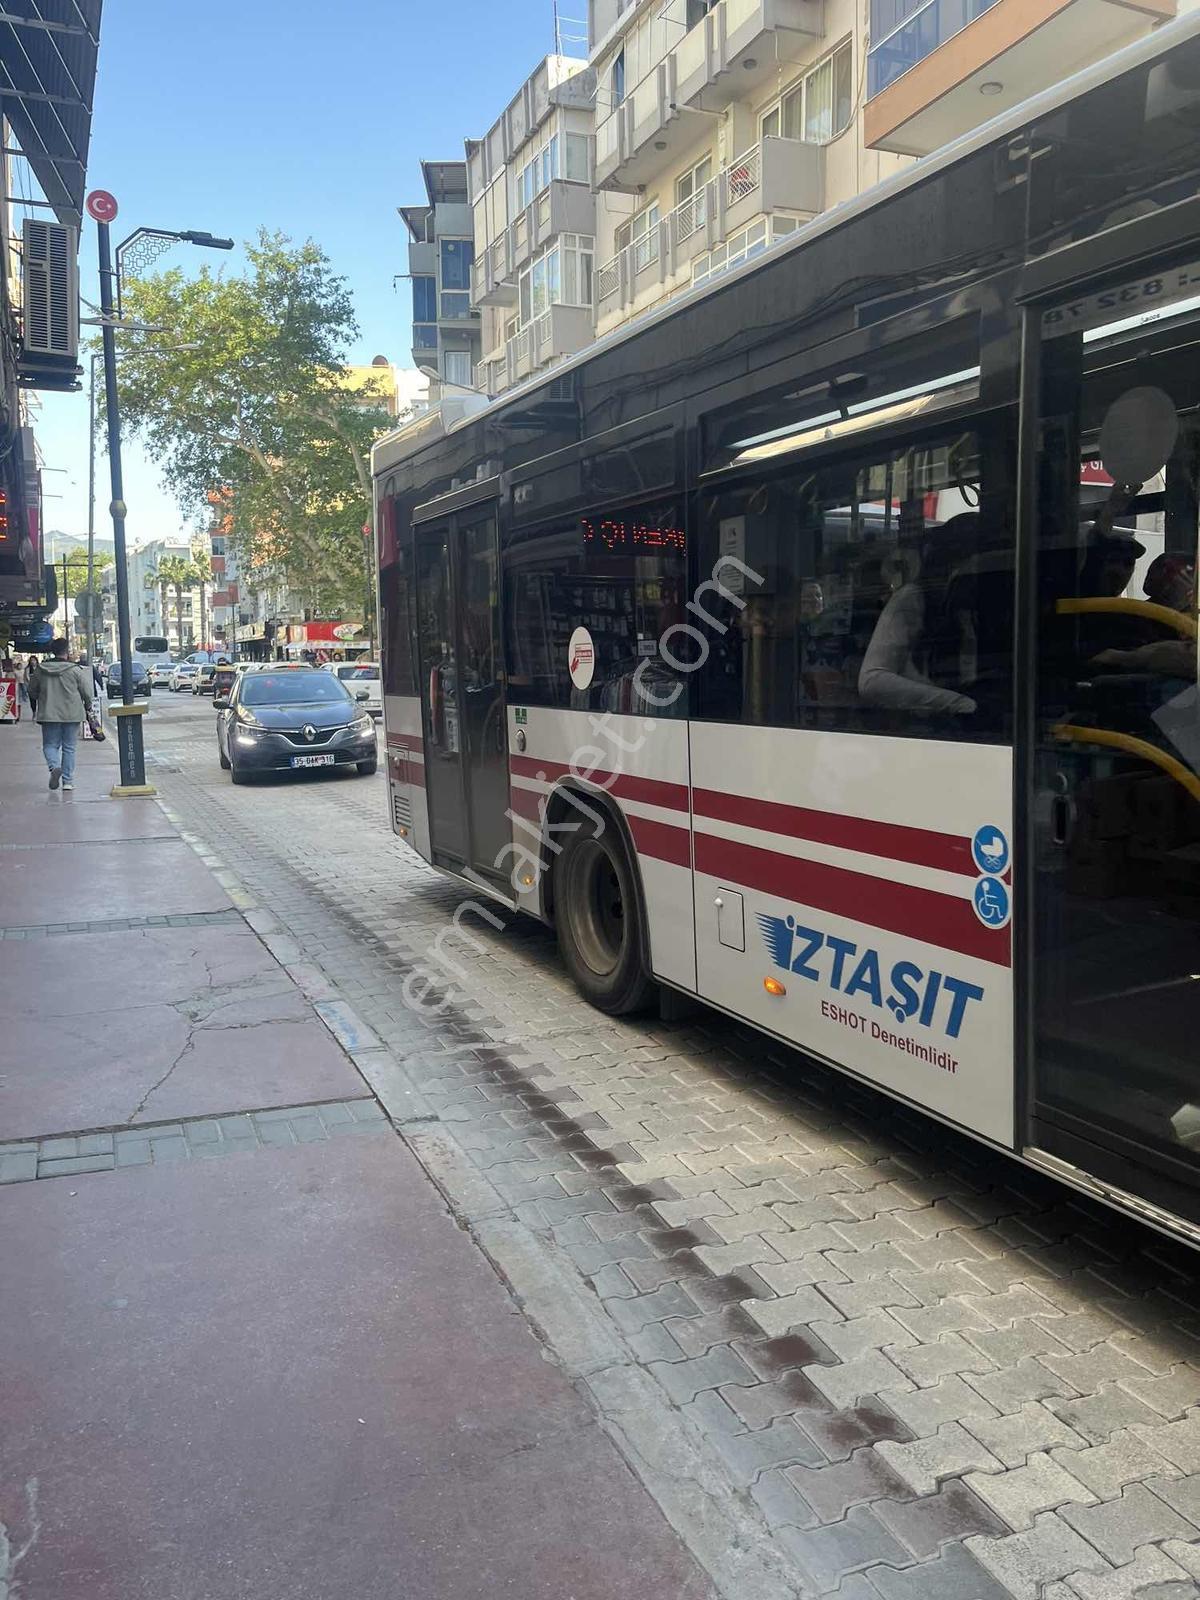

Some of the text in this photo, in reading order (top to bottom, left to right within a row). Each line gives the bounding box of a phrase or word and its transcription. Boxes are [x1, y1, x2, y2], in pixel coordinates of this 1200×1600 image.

[755, 912, 984, 1039] İZTAŞIT
[821, 1000, 959, 1074] ESHOT Denetimlidir
